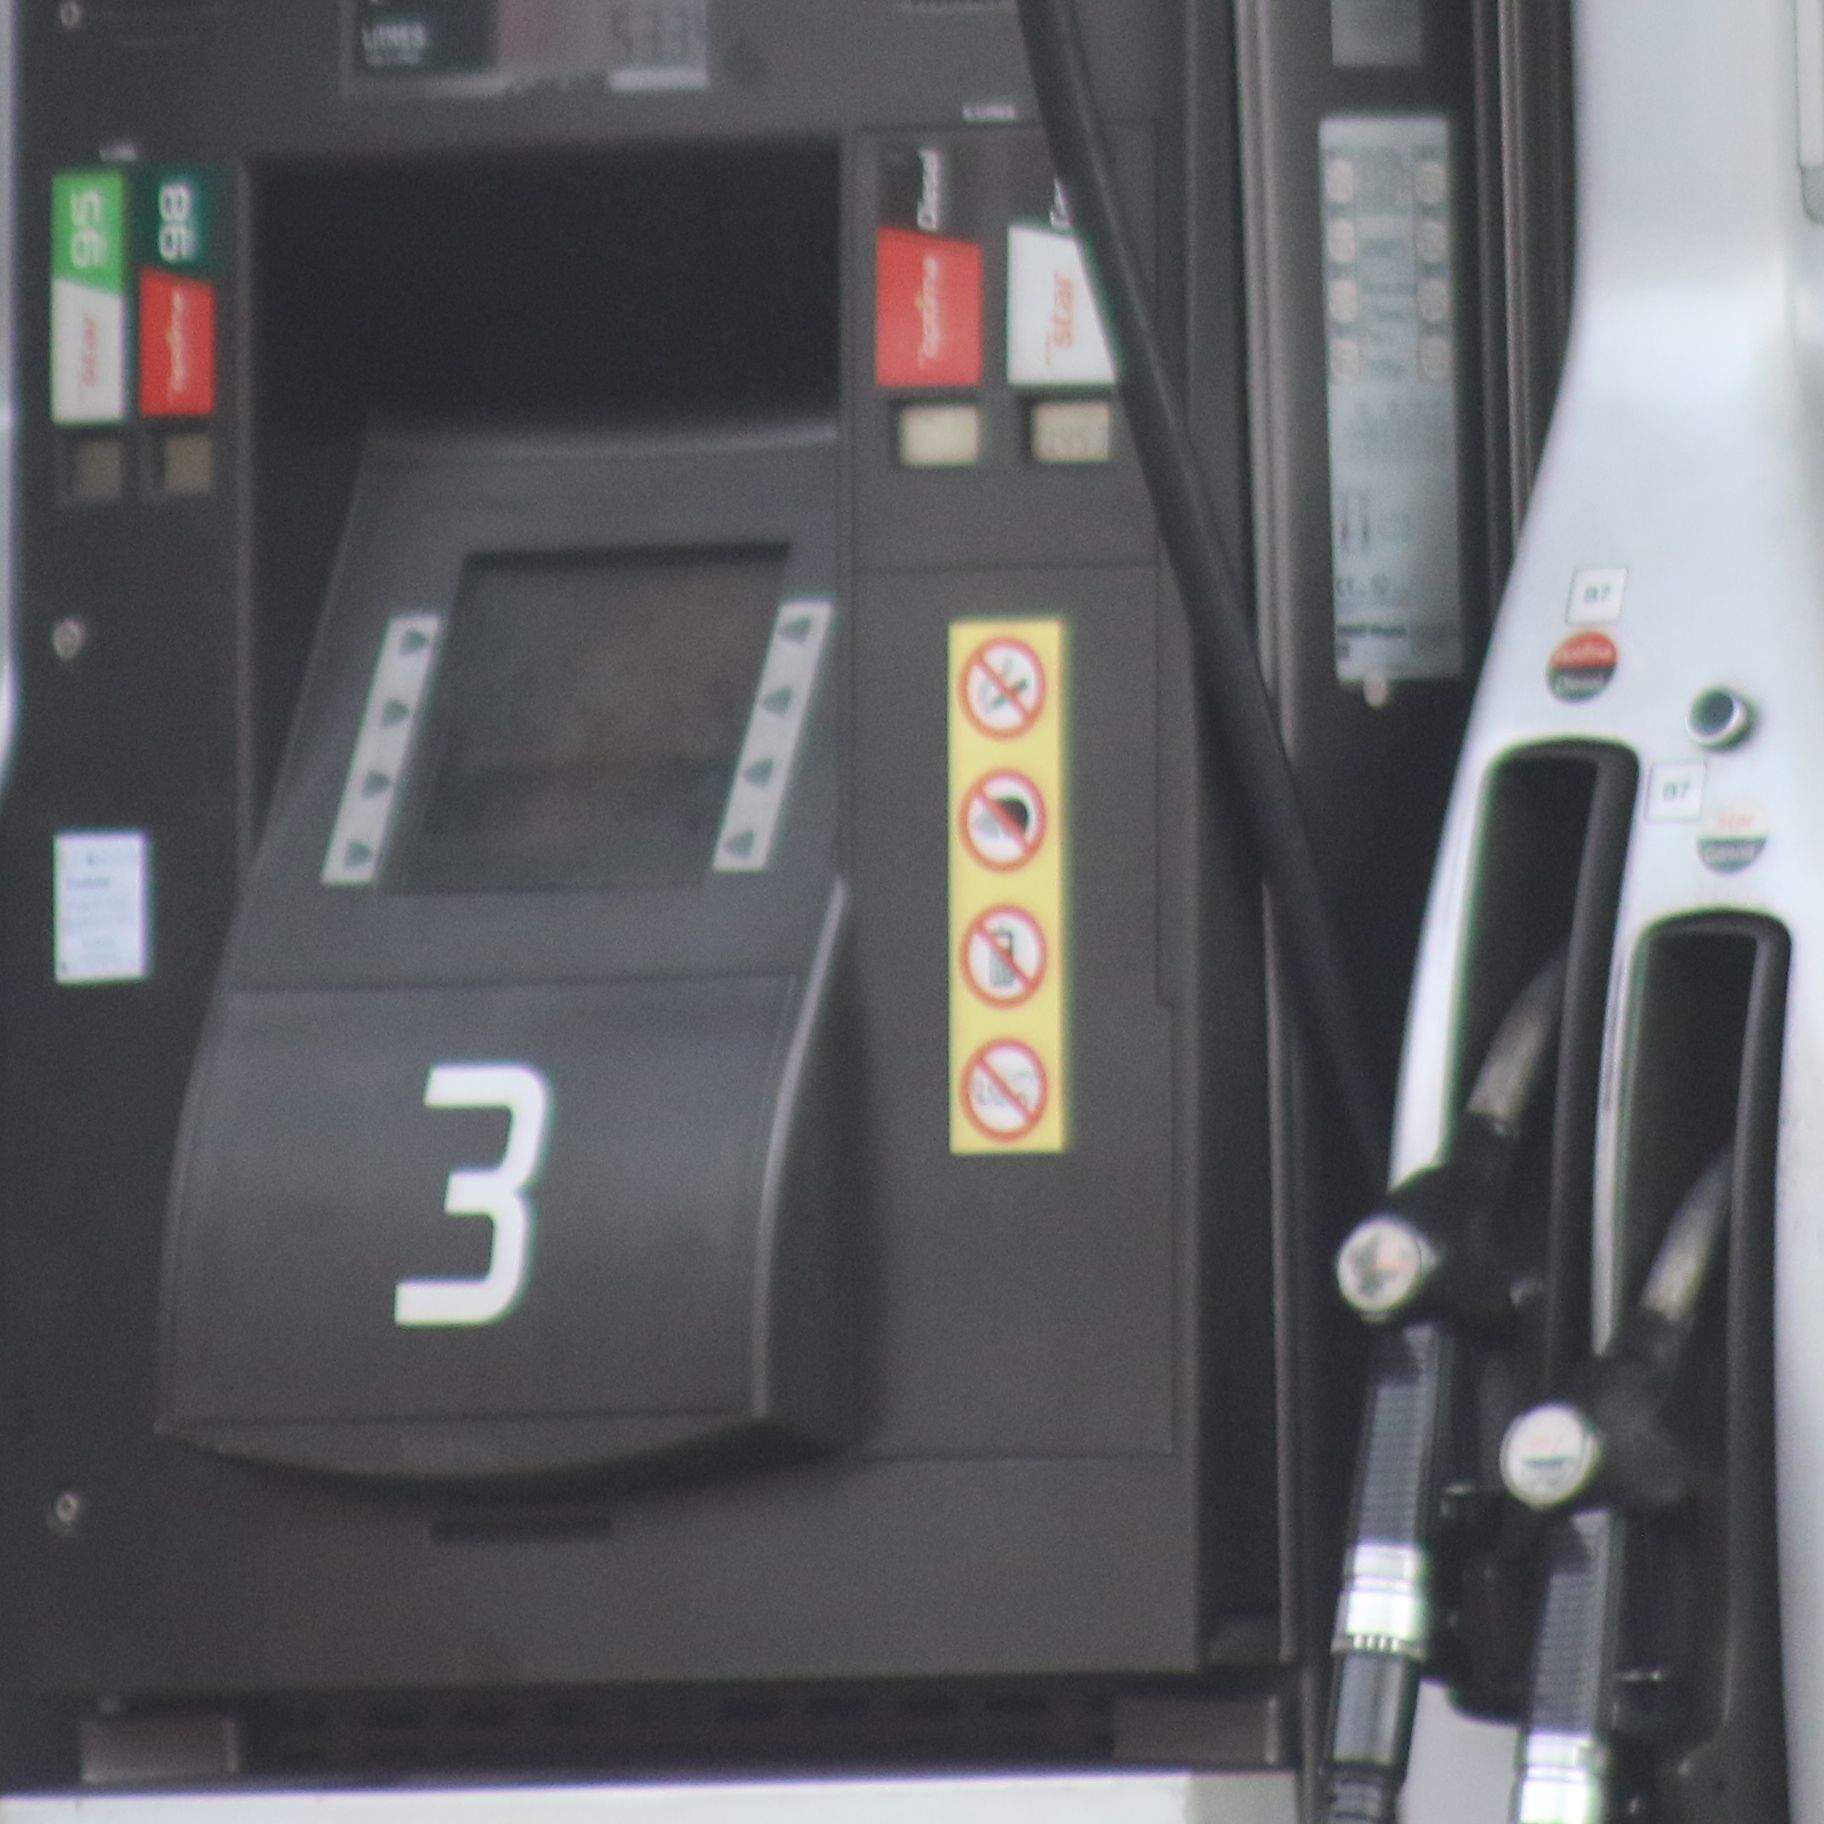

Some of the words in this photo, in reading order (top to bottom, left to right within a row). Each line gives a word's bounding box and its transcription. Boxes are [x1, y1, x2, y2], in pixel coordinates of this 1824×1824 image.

[70, 187, 108, 268] 95
[158, 182, 197, 263] 98
[917, 149, 942, 230] Diesel
[395, 1065, 551, 1325] 3
